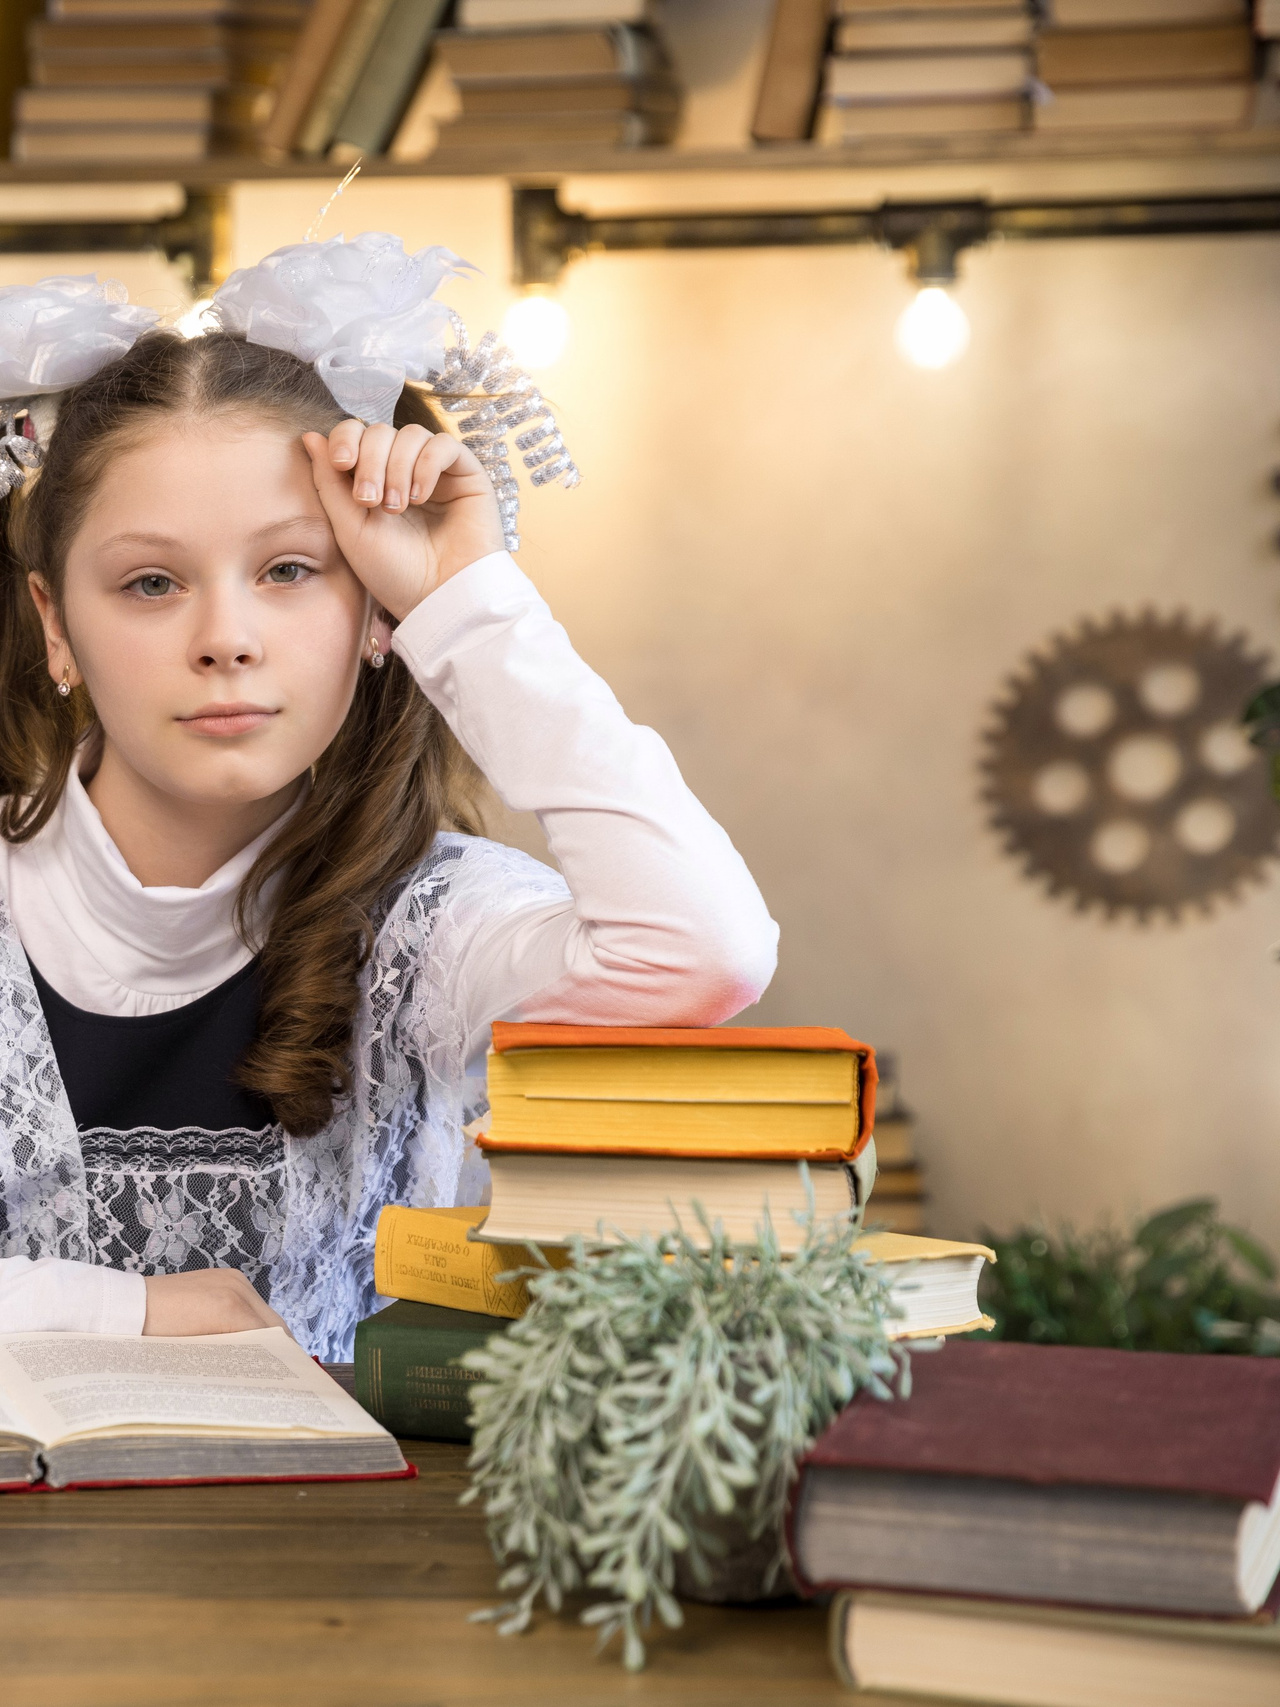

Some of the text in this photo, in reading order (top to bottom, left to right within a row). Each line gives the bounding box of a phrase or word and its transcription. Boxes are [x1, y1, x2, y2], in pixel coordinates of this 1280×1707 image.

[406, 1234, 461, 1255] ФОРСАЙТАХ
[424, 1254, 448, 1269] САГА
[450, 1275, 481, 1291] ДЖОН
